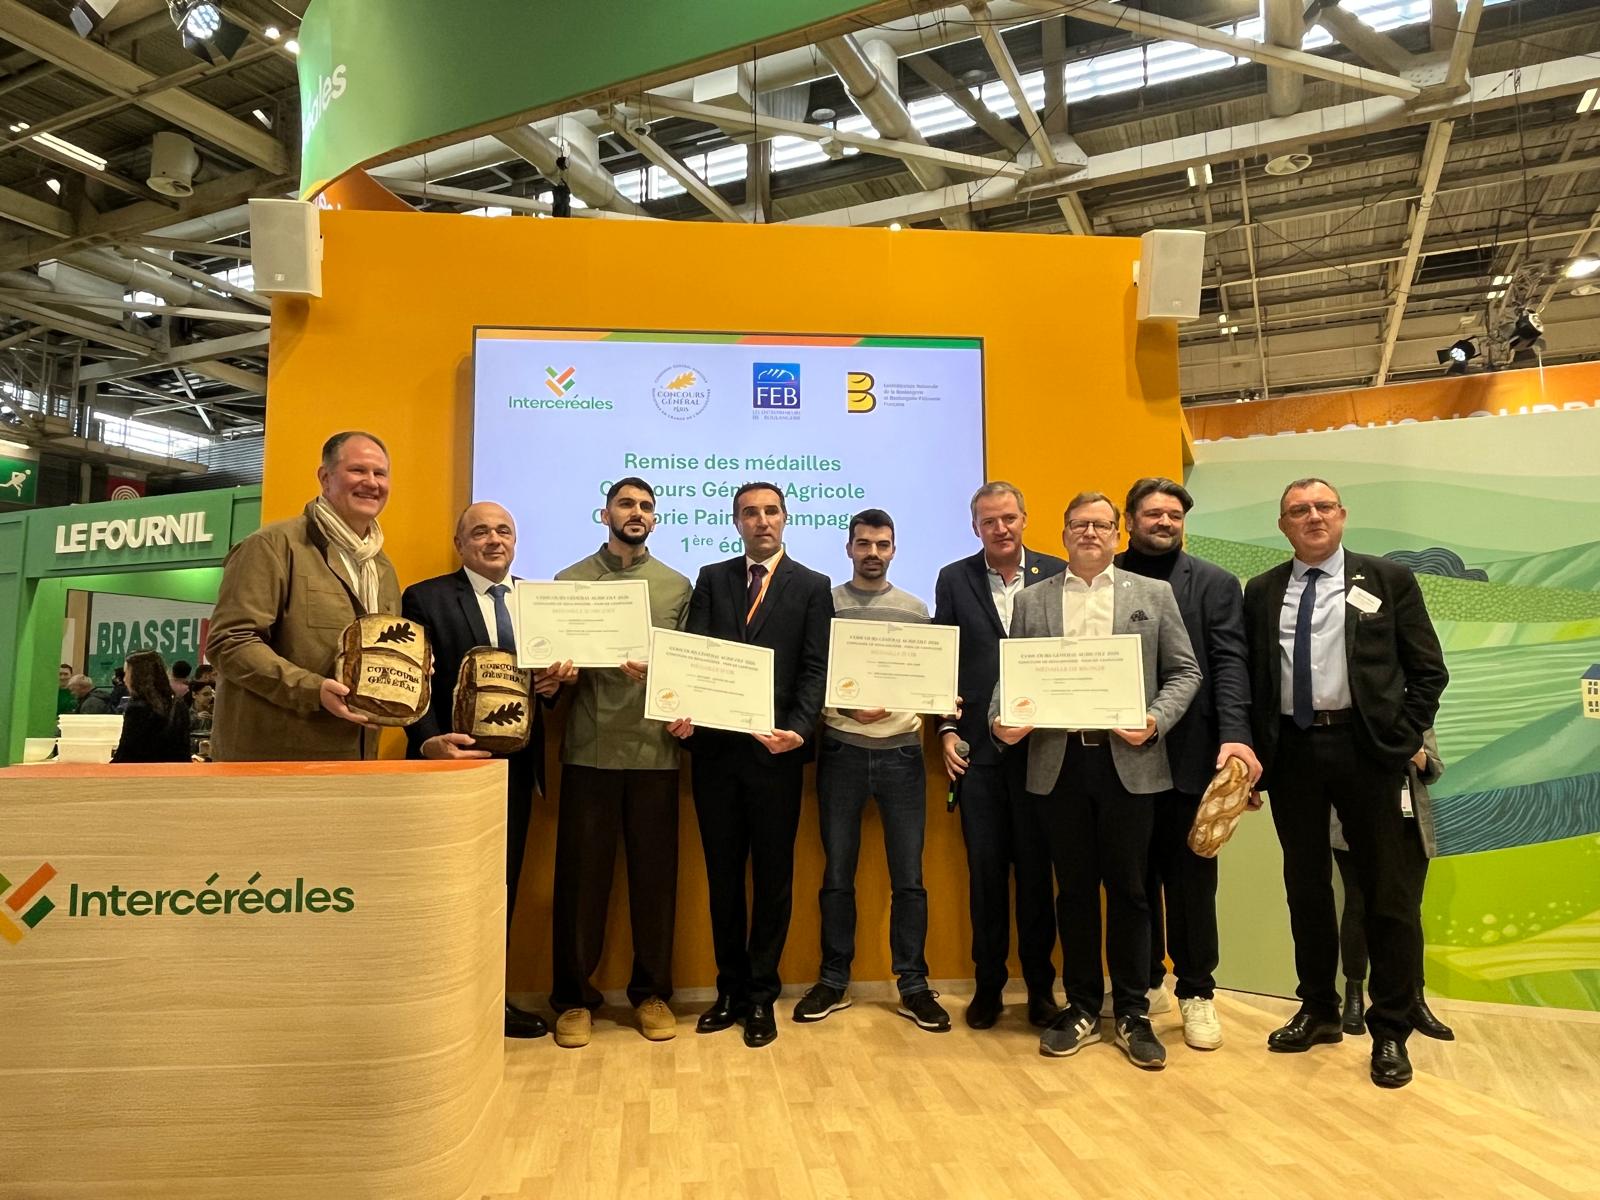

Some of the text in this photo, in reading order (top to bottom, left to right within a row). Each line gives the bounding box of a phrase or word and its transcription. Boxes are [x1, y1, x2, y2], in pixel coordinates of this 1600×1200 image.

[756, 387, 798, 406] FEB
[624, 453, 841, 471] Remise des médailles
[600, 480, 696, 497] Cours
[785, 482, 865, 502] Agricole
[55, 511, 214, 554] LE FOURNIL
[681, 535, 714, 553] 1ère
[367, 666, 420, 684] CONCOURS
[69, 871, 355, 917] Intercéréales
